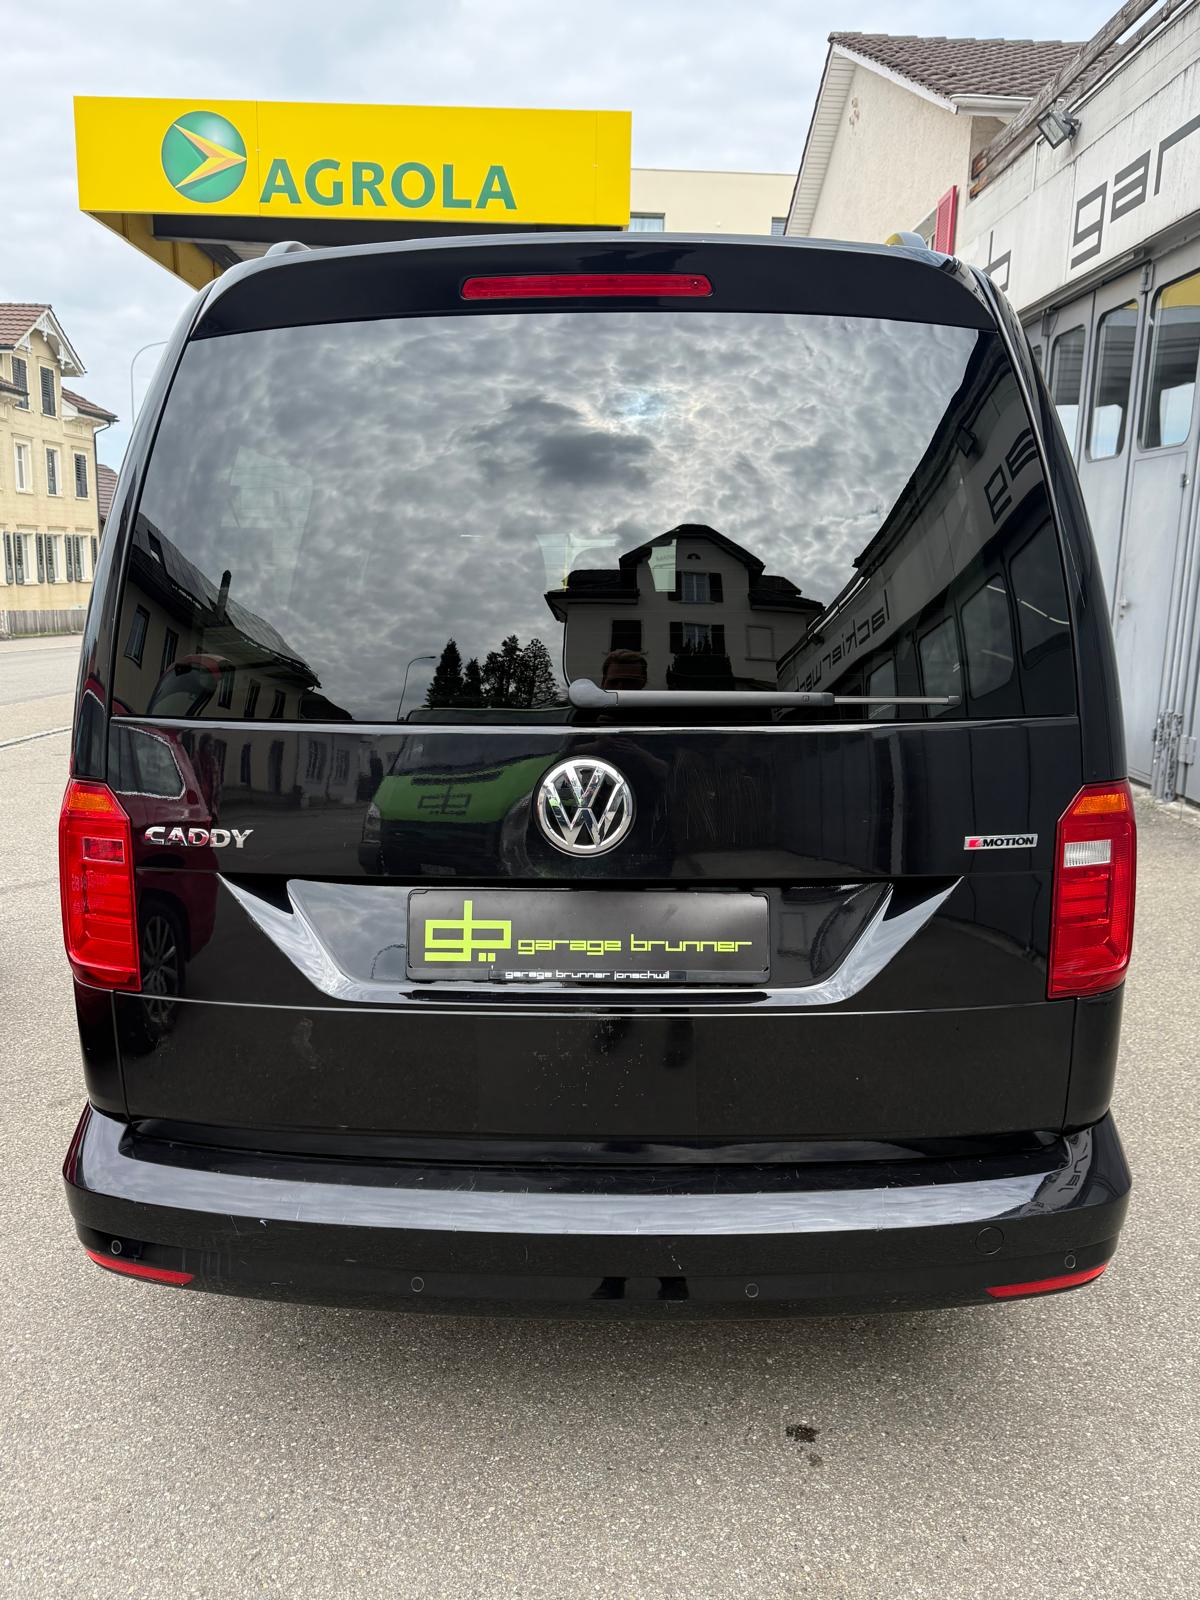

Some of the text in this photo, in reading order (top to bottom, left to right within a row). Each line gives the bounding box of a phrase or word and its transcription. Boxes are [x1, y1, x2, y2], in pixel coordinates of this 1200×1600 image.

[259, 158, 517, 210] AGROLA
[144, 826, 254, 848] CADDY
[518, 934, 752, 955] garage brunner
[505, 969, 669, 980] garage brunner jonschwil
